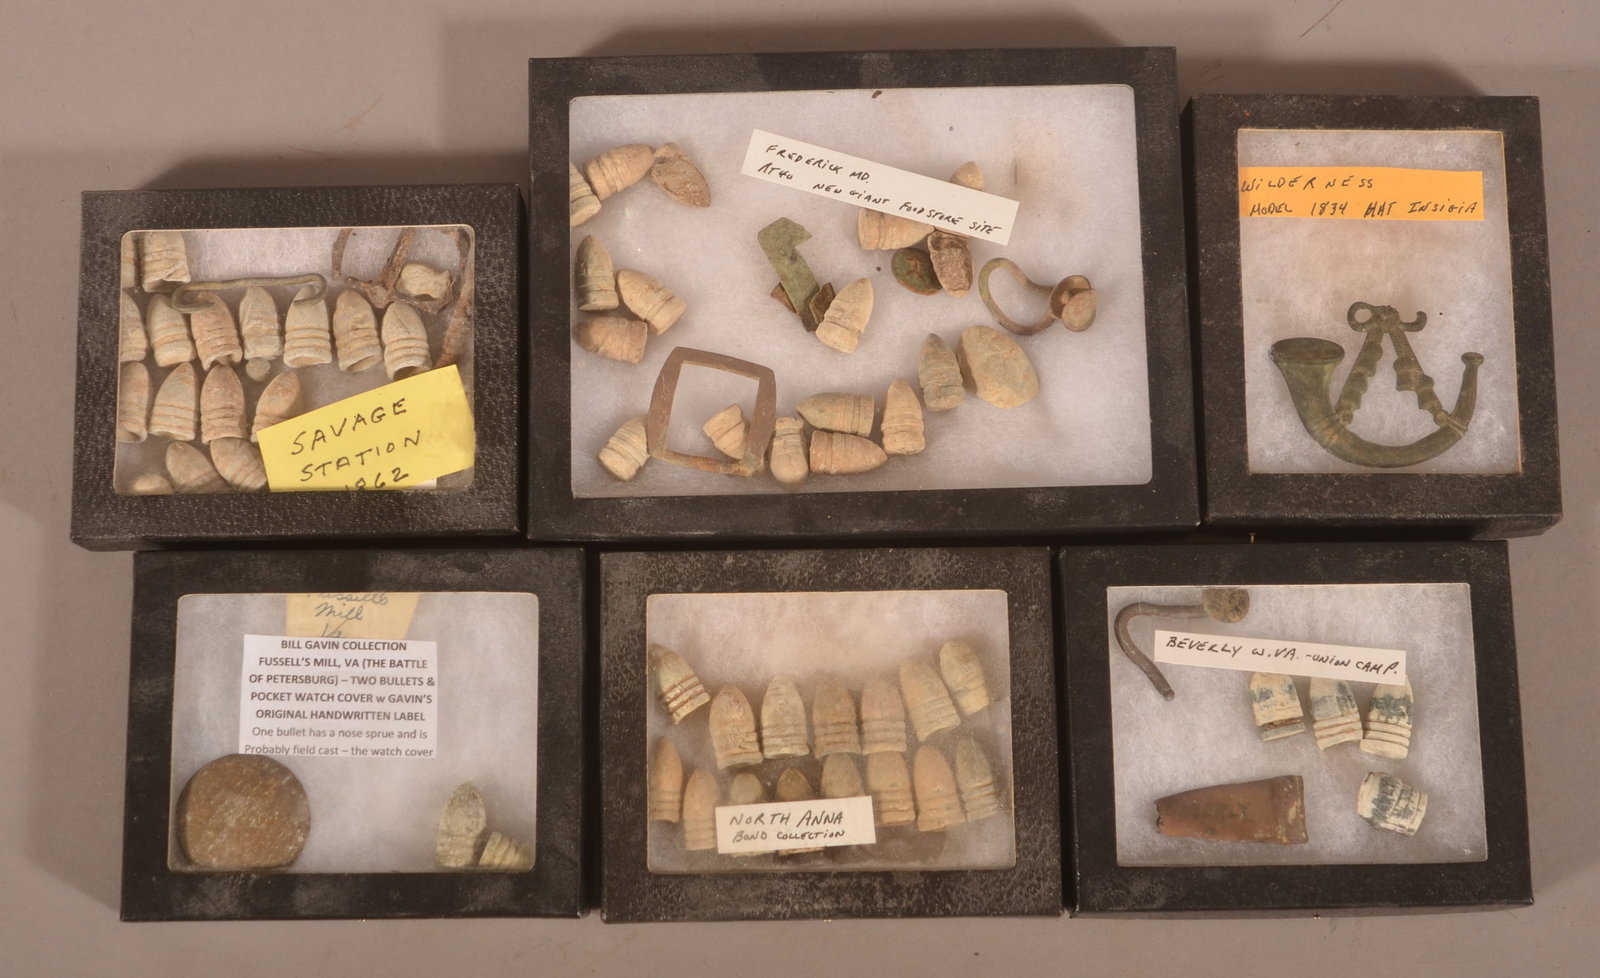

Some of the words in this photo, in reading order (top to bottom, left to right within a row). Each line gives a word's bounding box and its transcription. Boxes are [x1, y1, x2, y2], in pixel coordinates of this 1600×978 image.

[766, 145, 843, 174] FREDERICK
[812, 184, 842, 194] NEW
[849, 189, 890, 205] GIANT
[969, 221, 1002, 234] SITE
[1250, 202, 1292, 216] MODEL
[1311, 201, 1348, 216] 1834
[1364, 201, 1397, 218] HAT
[291, 398, 407, 455] SAVAGE
[300, 430, 421, 482] STATION
[314, 602, 364, 620] Mill
[281, 640, 301, 649] BILL
[305, 641, 339, 650] GAVIN
[342, 642, 407, 651] COLLECTION
[1166, 636, 1243, 658] BEVERLY
[314, 658, 341, 669] MILL,
[345, 658, 360, 667] VA
[362, 658, 386, 669] (THE
[390, 659, 427, 668] BATTLE
[249, 674, 263, 683] OF
[266, 674, 338, 686] PETERSBURG)
[351, 676, 376, 685] TWO
[380, 676, 423, 686] BULLETS
[426, 677, 435, 686] &
[250, 692, 292, 701] POCKET
[295, 692, 334, 702] WATCH
[338, 693, 373, 703] COVER
[256, 709, 308, 719] ORIGINAL
[310, 710, 390, 720] HANDWRITTEN
[394, 712, 425, 721] LABEL
[252, 727, 273, 737] One
[276, 727, 306, 737] bullet
[309, 728, 326, 737] has
[366, 730, 394, 740] sprue
[397, 729, 417, 738] and
[420, 729, 427, 738] is
[245, 744, 290, 755] Probably
[293, 745, 315, 755] field
[318, 746, 338, 755] cast
[351, 746, 368, 755] the
[371, 746, 402, 756] watch
[405, 748, 433, 757] cover
[729, 812, 791, 826] NORTH
[796, 810, 843, 827] ANNA
[732, 830, 768, 843] BOND
[776, 829, 845, 840] COLLECTION
